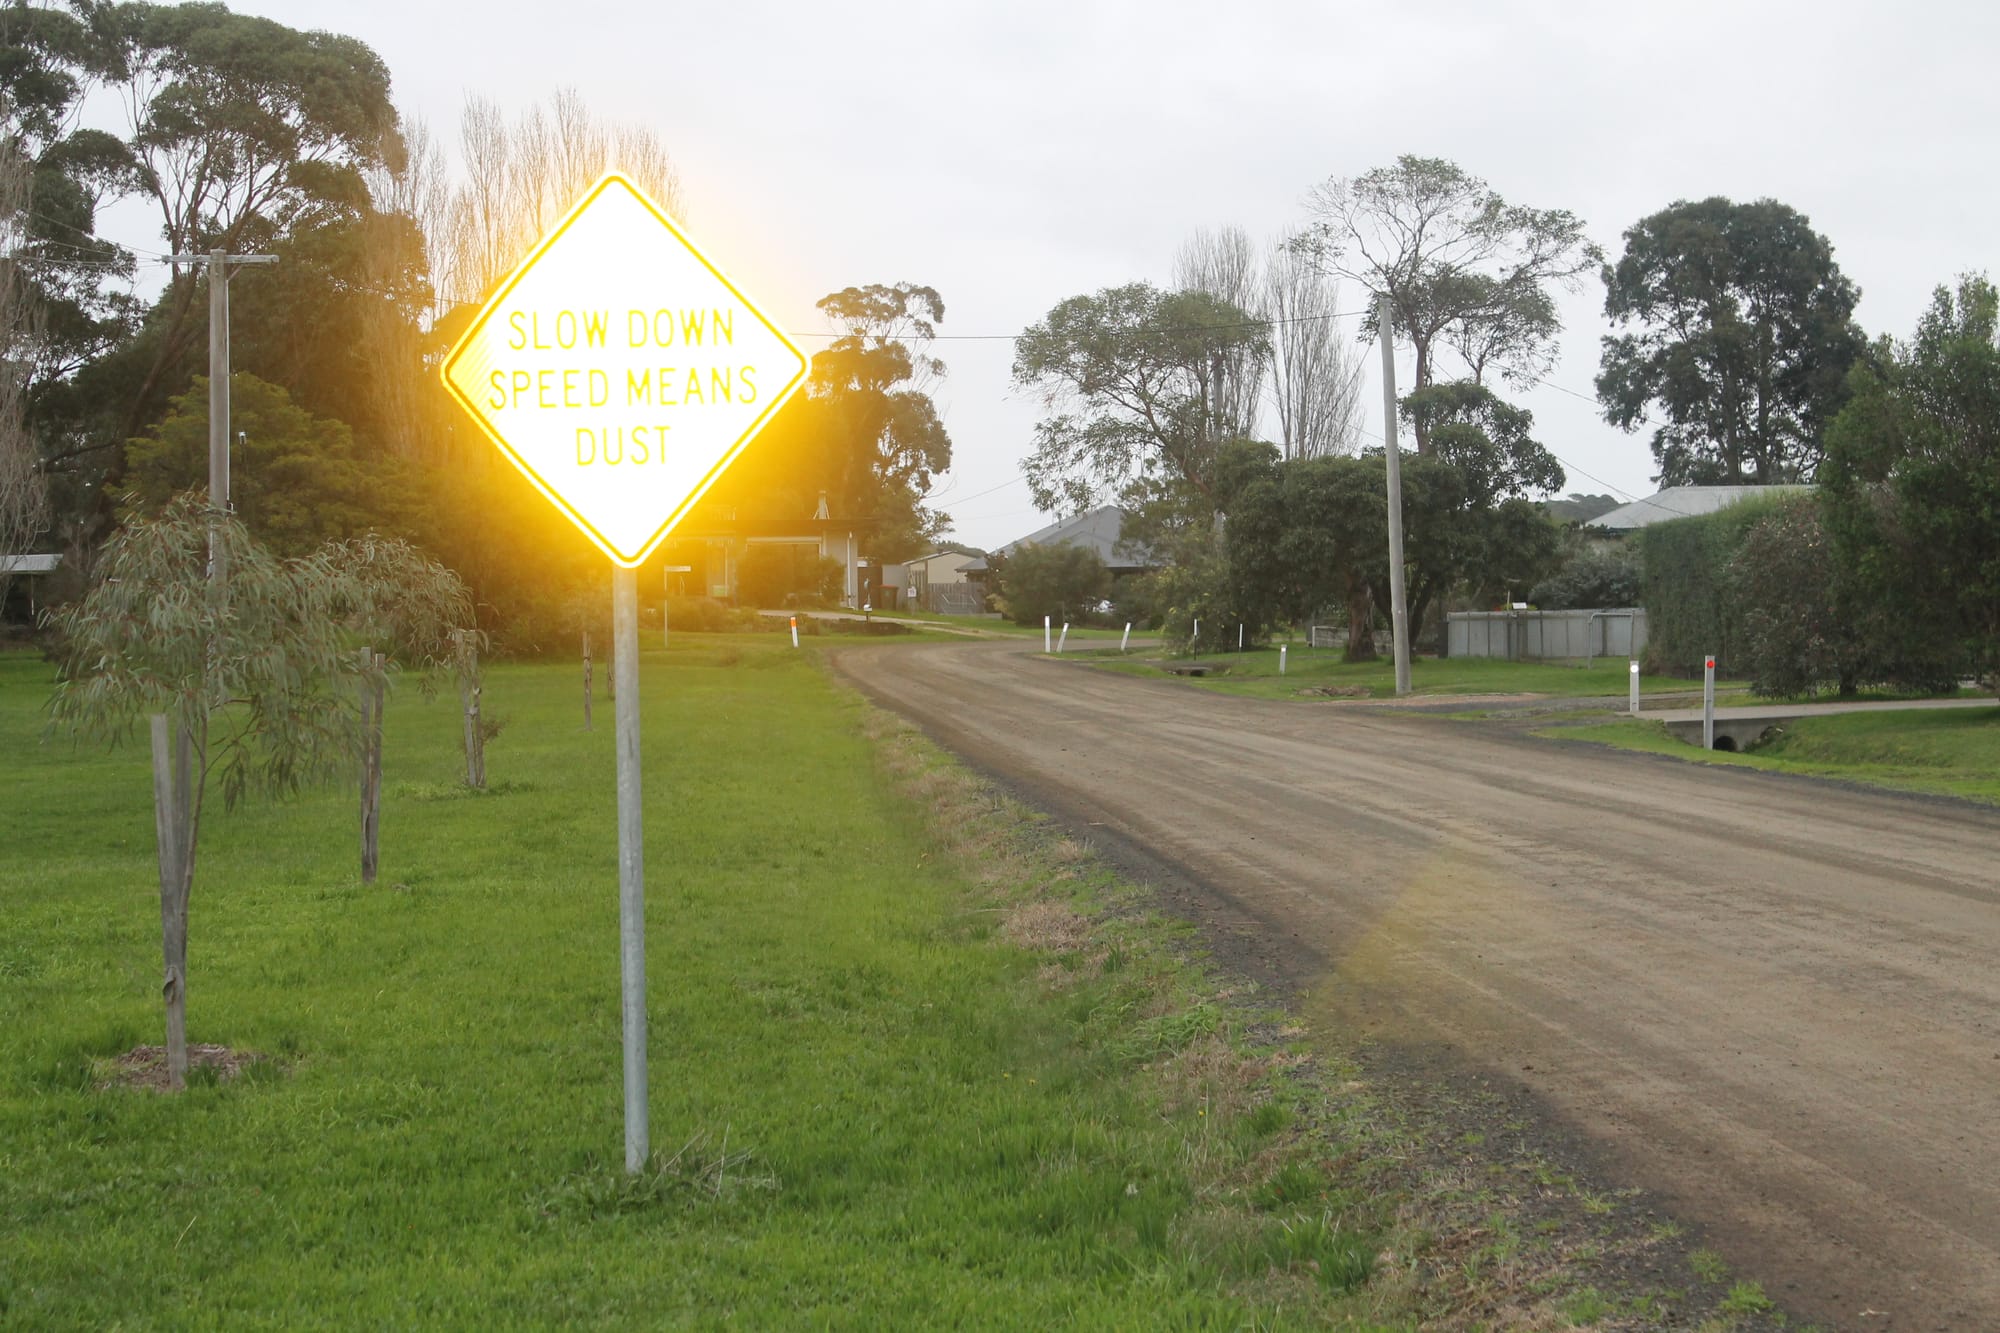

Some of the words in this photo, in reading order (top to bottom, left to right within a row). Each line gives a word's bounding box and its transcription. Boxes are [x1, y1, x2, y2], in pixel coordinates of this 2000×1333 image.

[508, 309, 609, 351] SLOW
[628, 308, 733, 348] DOWN
[489, 369, 609, 411] SPEED
[627, 365, 757, 406] MEANS
[575, 425, 671, 467] DUST
